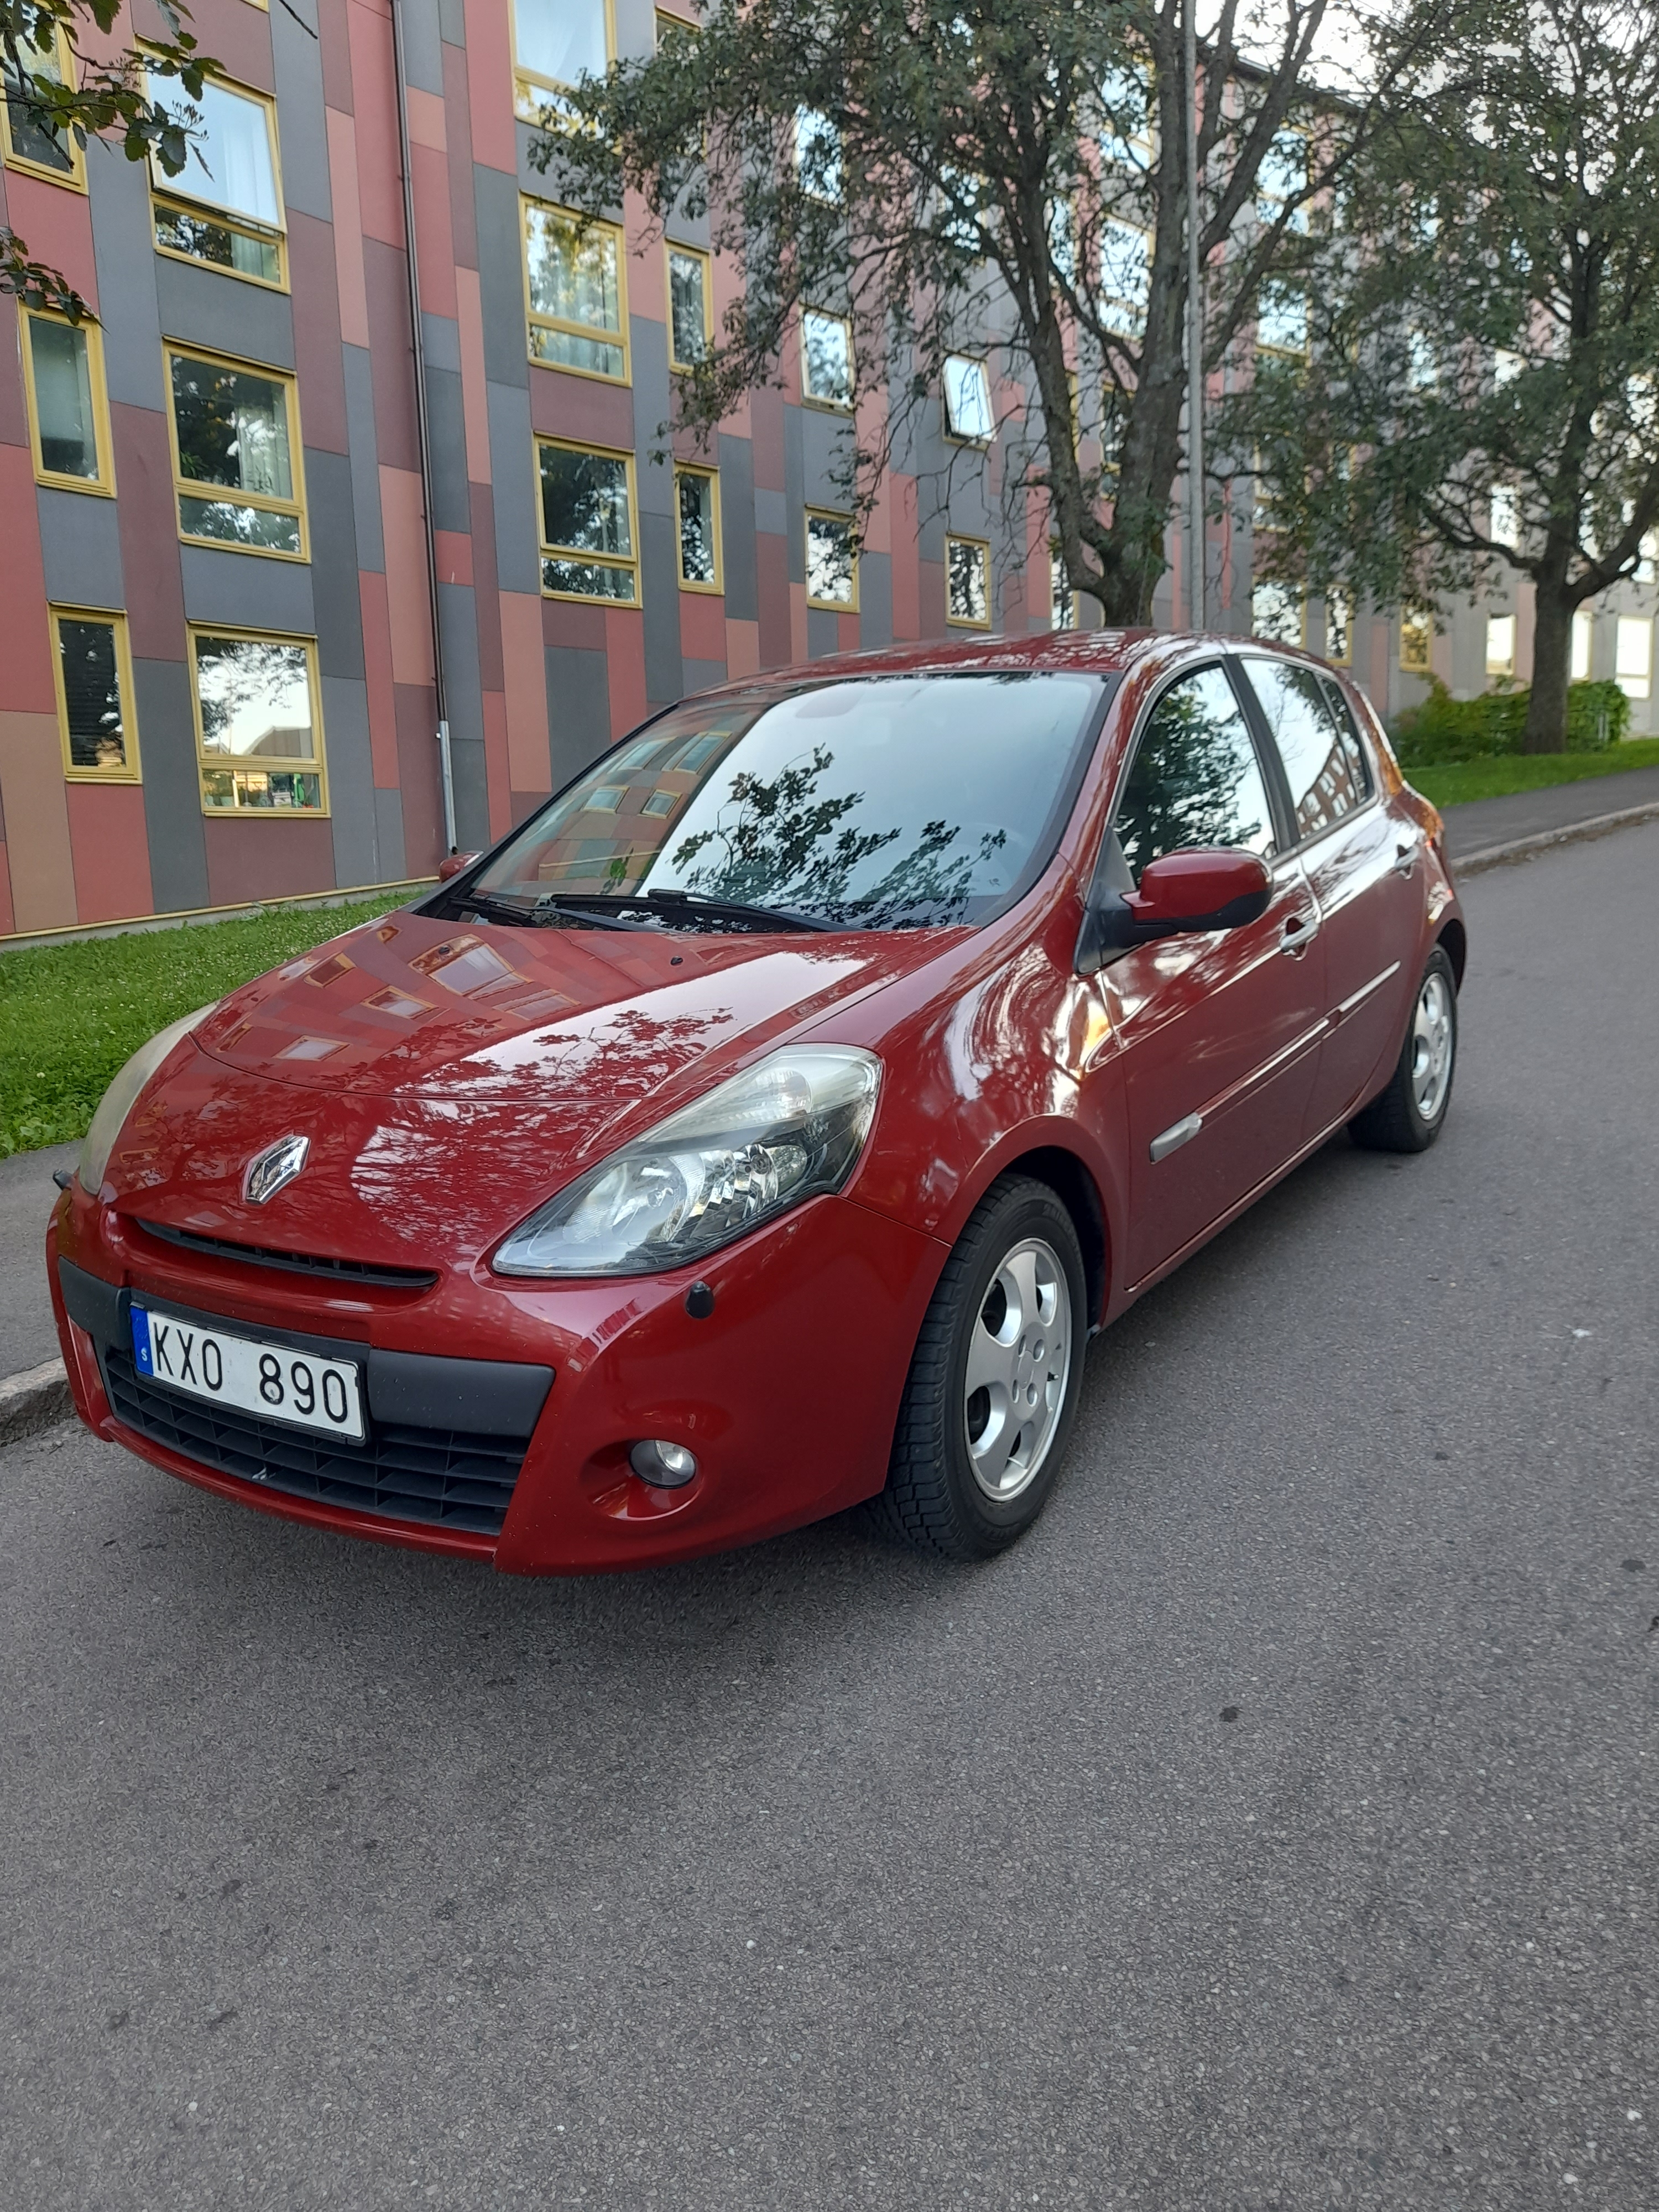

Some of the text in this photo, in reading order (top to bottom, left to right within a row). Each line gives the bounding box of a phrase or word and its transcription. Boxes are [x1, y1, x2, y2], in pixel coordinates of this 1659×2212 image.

[140, 1348, 148, 1361] S
[153, 1322, 348, 1423] KXO 890
